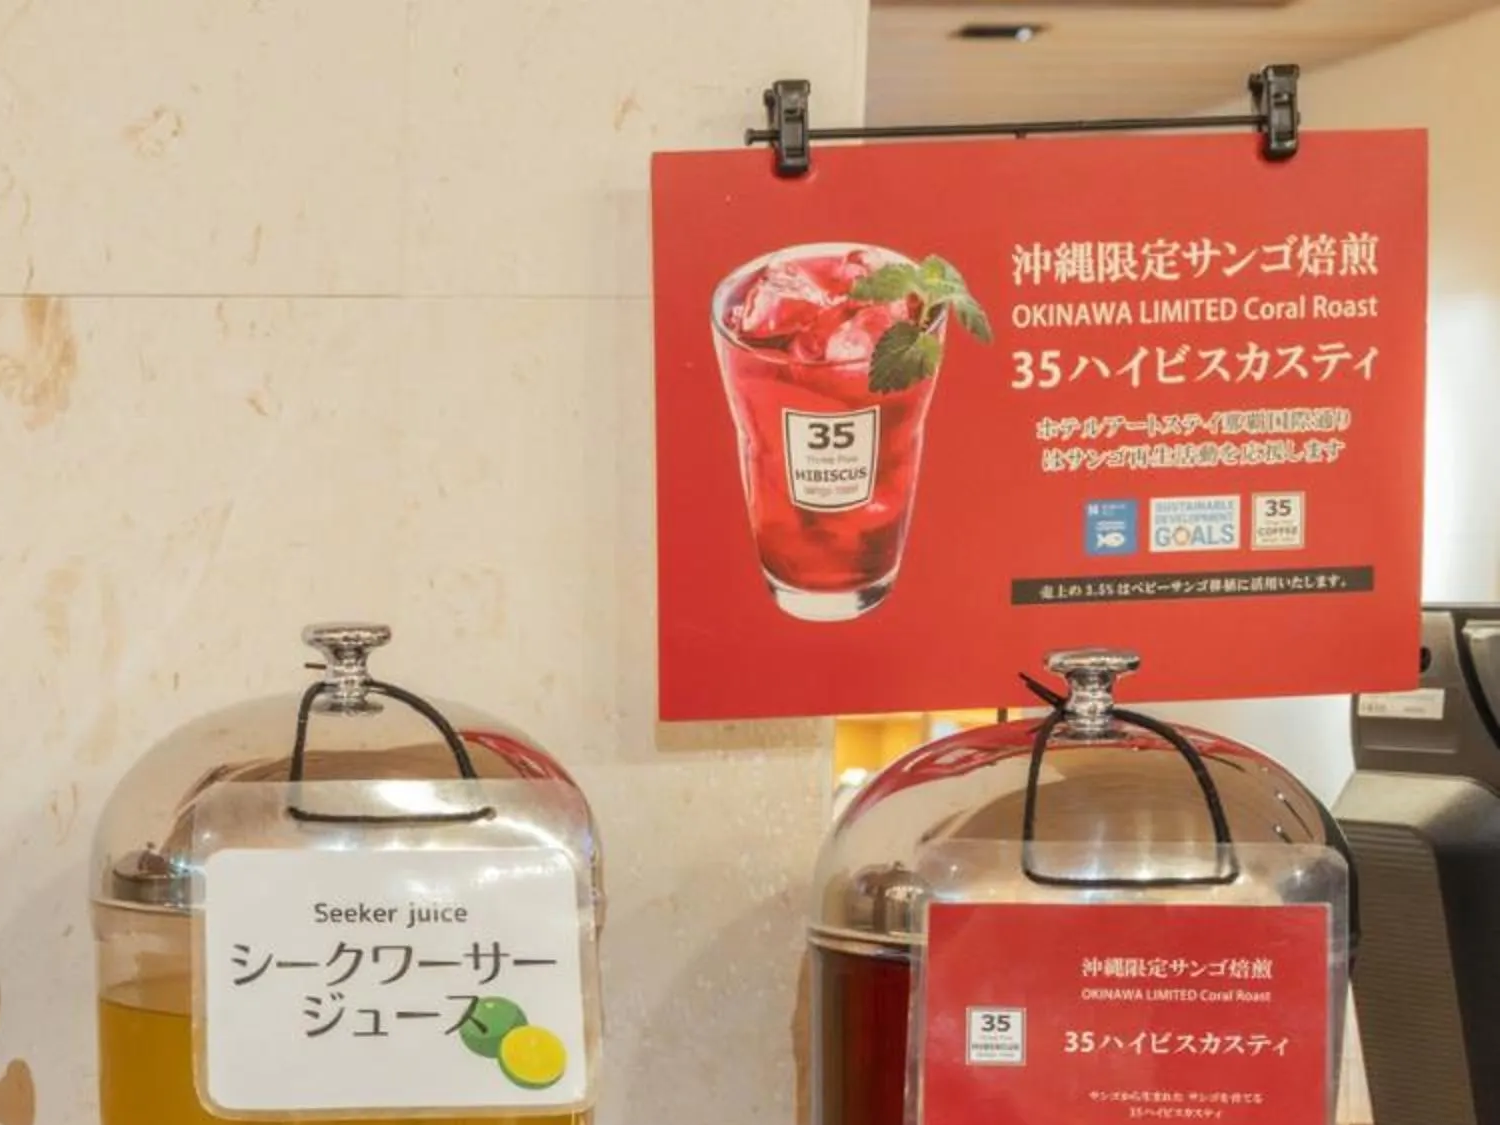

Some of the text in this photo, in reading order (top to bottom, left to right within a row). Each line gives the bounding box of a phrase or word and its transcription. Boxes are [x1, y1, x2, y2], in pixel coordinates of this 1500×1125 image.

[1011, 231, 1379, 286] 沖縄限定サンゴ焙煎
[1011, 294, 1378, 329] OKINAWA LIMITED Coral Roast
[807, 421, 856, 450] 35
[1042, 438, 1346, 472] はサンゴ再生活動を応援します
[795, 467, 868, 483] HIBISCUS
[1155, 500, 1234, 513] SUSTAINABLE
[1265, 499, 1292, 517] 35
[1155, 513, 1234, 524] DEVELOPMENT
[1155, 523, 1235, 547] GOALS
[1258, 526, 1298, 537] COFFEE
[314, 902, 468, 928] Seeker juice
[229, 941, 557, 986] シークワーサー
[1081, 957, 1272, 980] 沖縄限定サンゴ焙煎
[1081, 988, 1271, 1002] OKINAWA LIMITED Coral Roast
[302, 992, 488, 1038] ジュース
[981, 1014, 1011, 1032] 35
